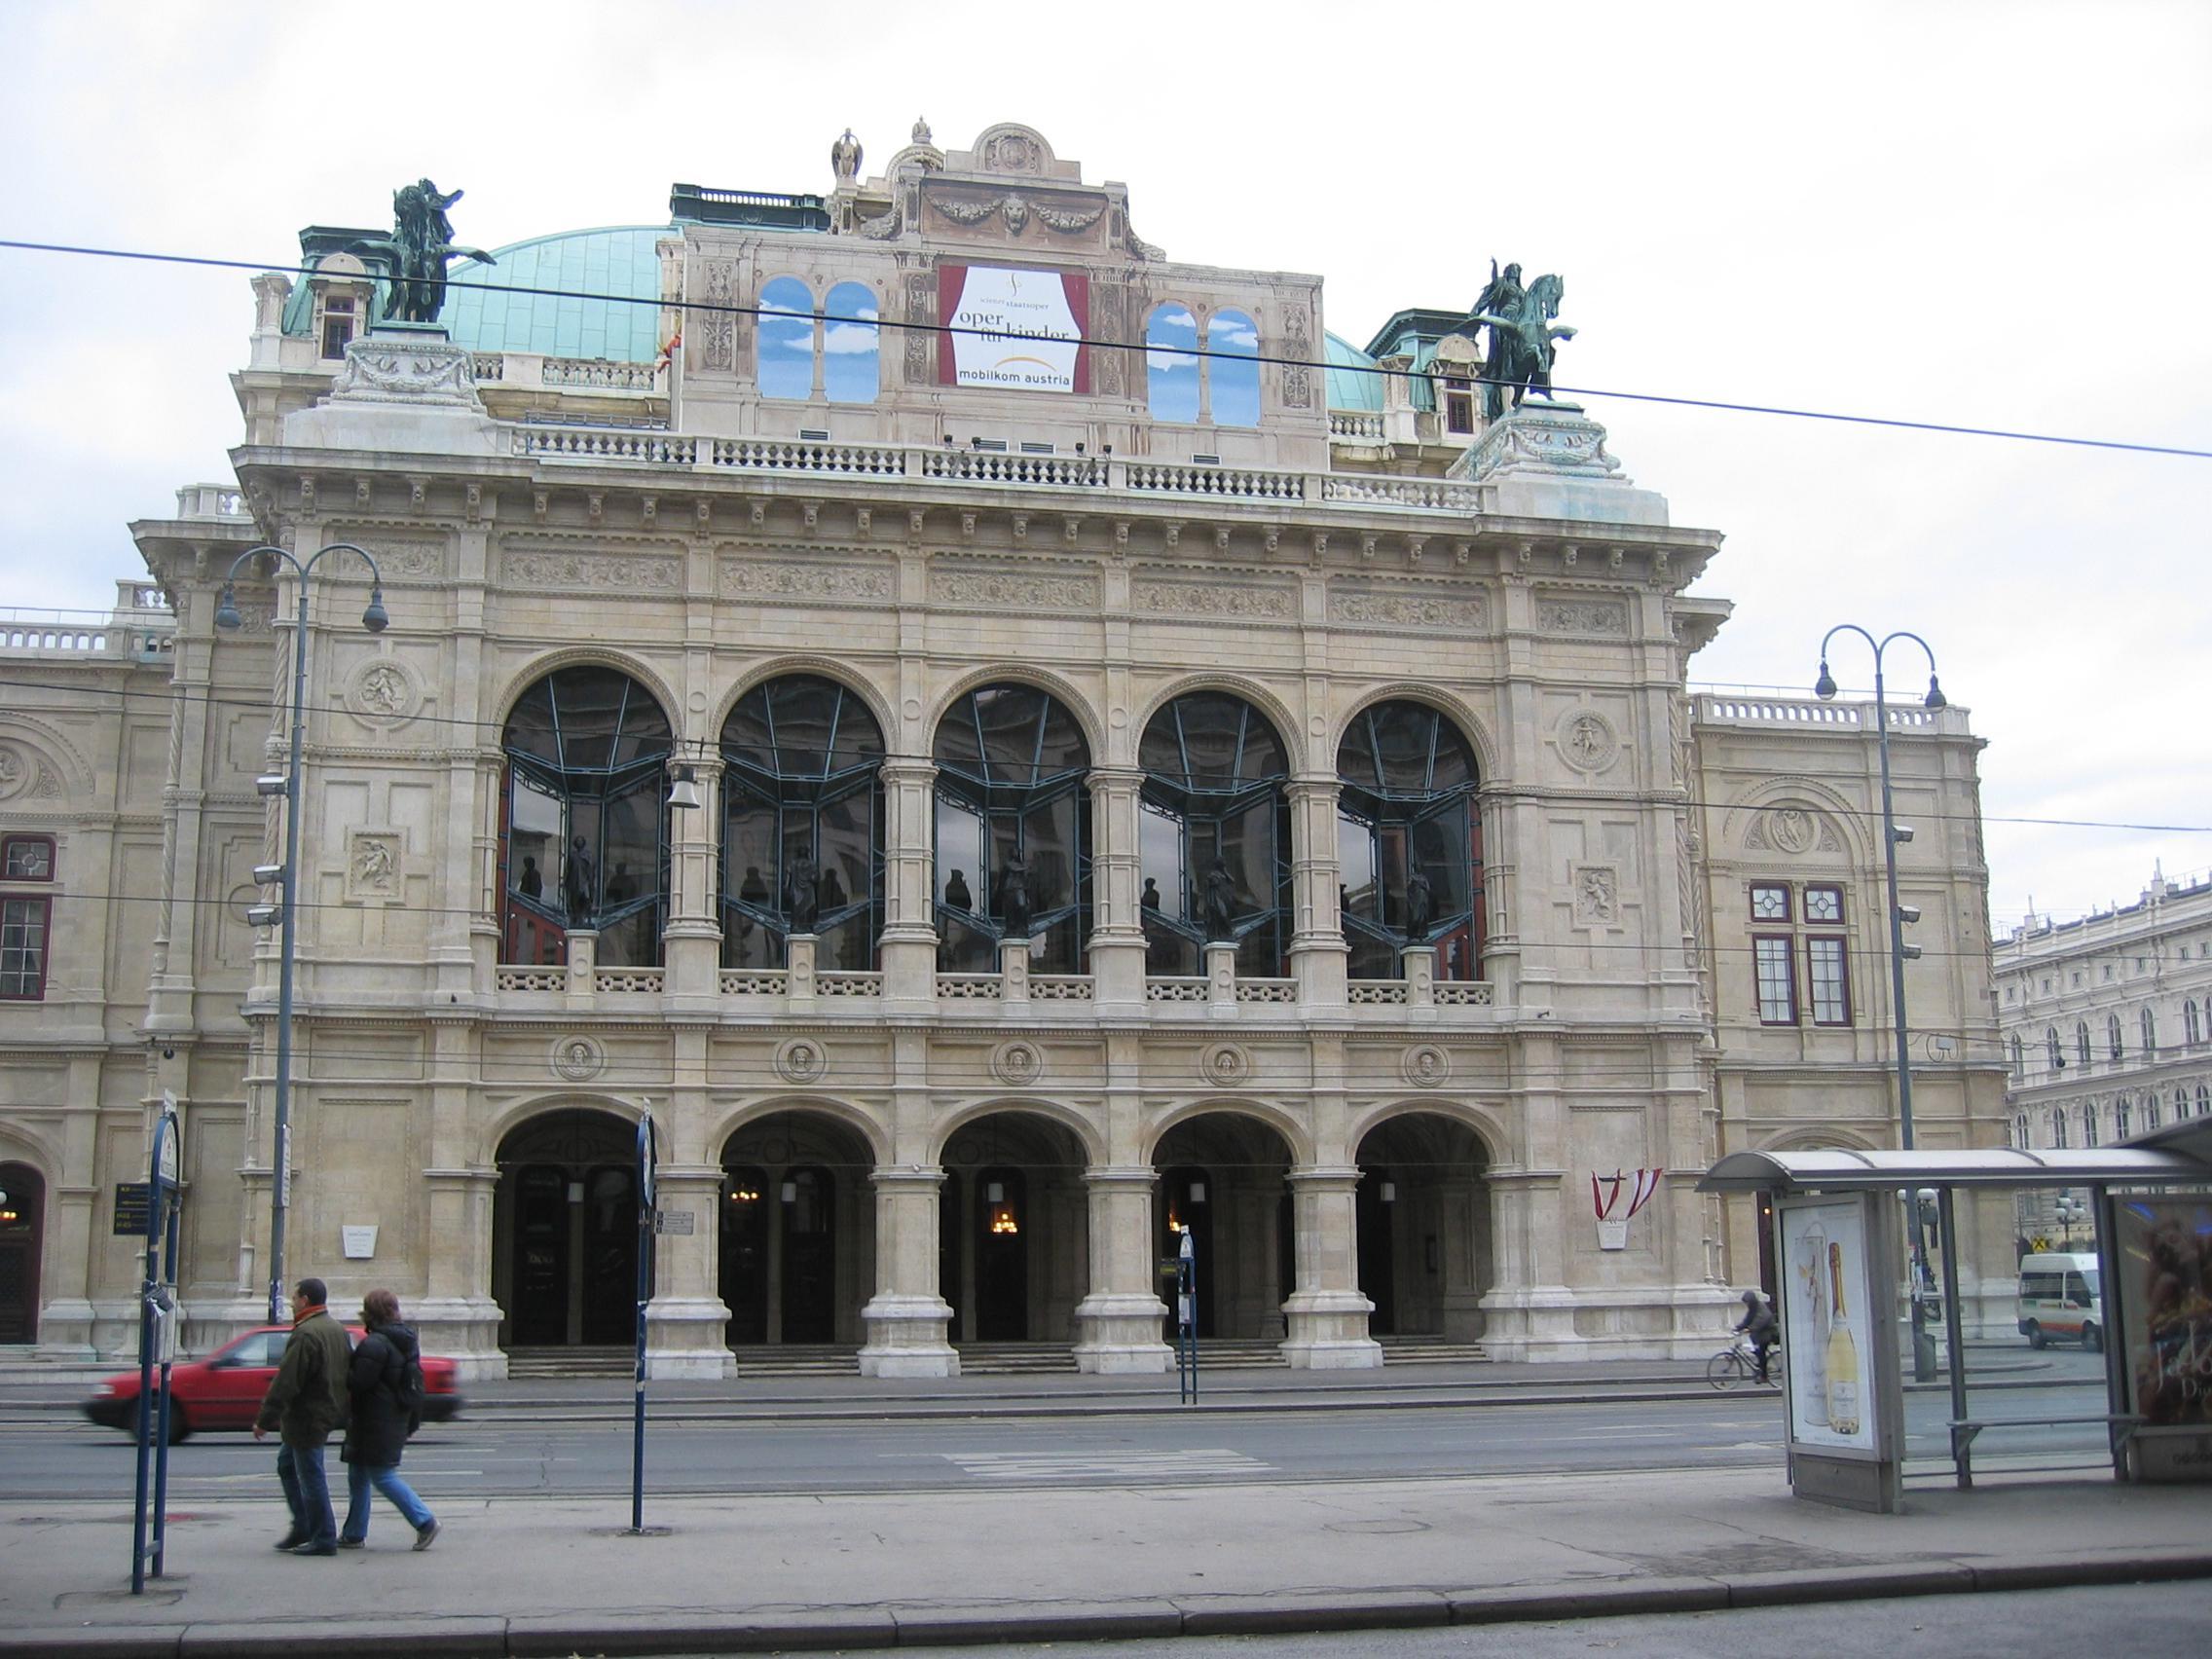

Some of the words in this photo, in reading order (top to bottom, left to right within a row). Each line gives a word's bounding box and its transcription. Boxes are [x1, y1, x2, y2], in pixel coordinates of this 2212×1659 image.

[1006, 300, 1050, 311] staatsoper
[959, 312, 1004, 327] oper
[1006, 322, 1069, 342] kinder
[959, 369, 1020, 383] mobilkom
[1024, 372, 1070, 386] austria
